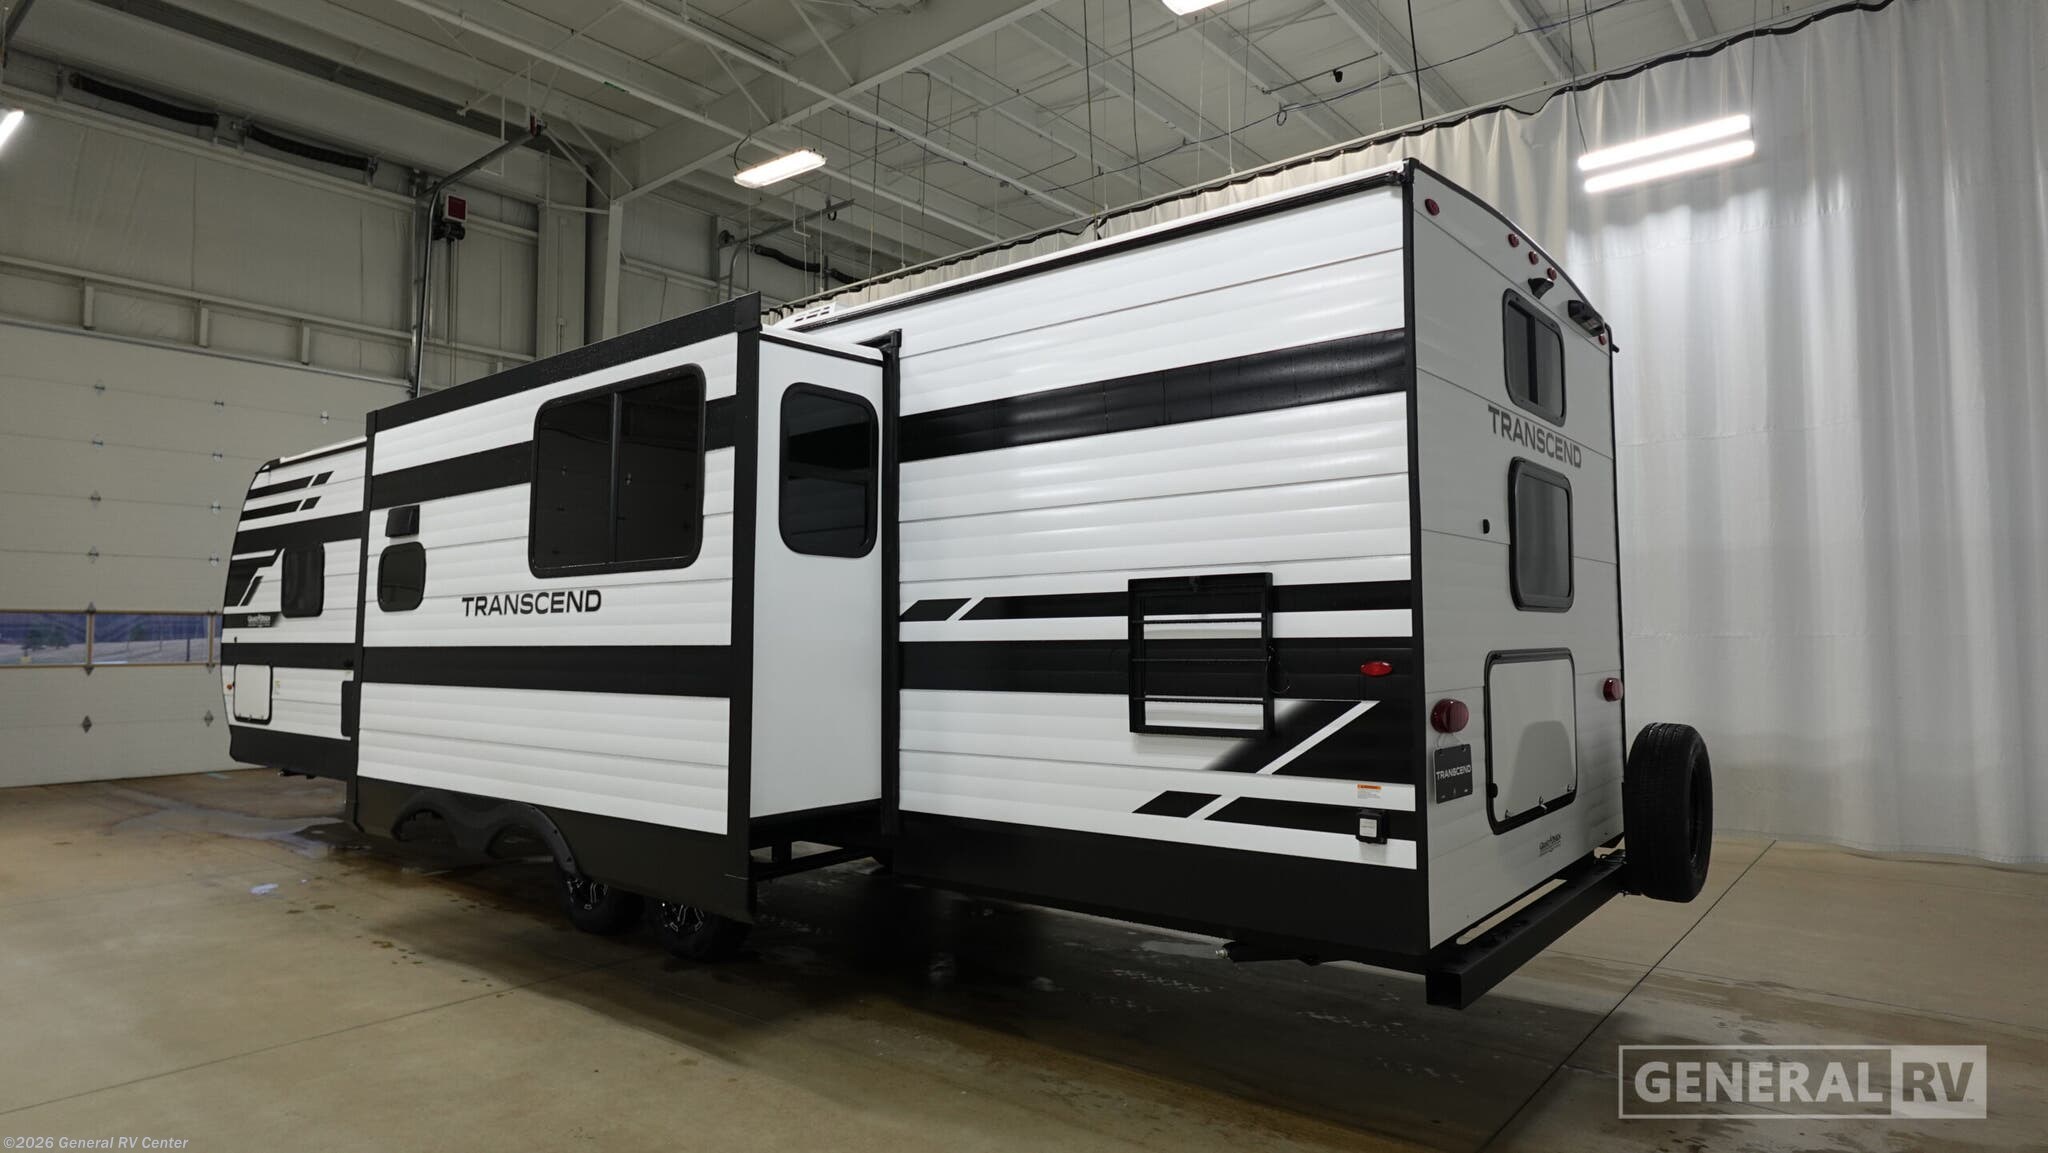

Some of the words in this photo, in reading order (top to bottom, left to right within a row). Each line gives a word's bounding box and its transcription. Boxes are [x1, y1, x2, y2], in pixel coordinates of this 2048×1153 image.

[1487, 404, 1582, 468] TRANSCEND
[461, 589, 602, 617] TRANSCEND
[1435, 764, 1472, 781] TRANSCEND
